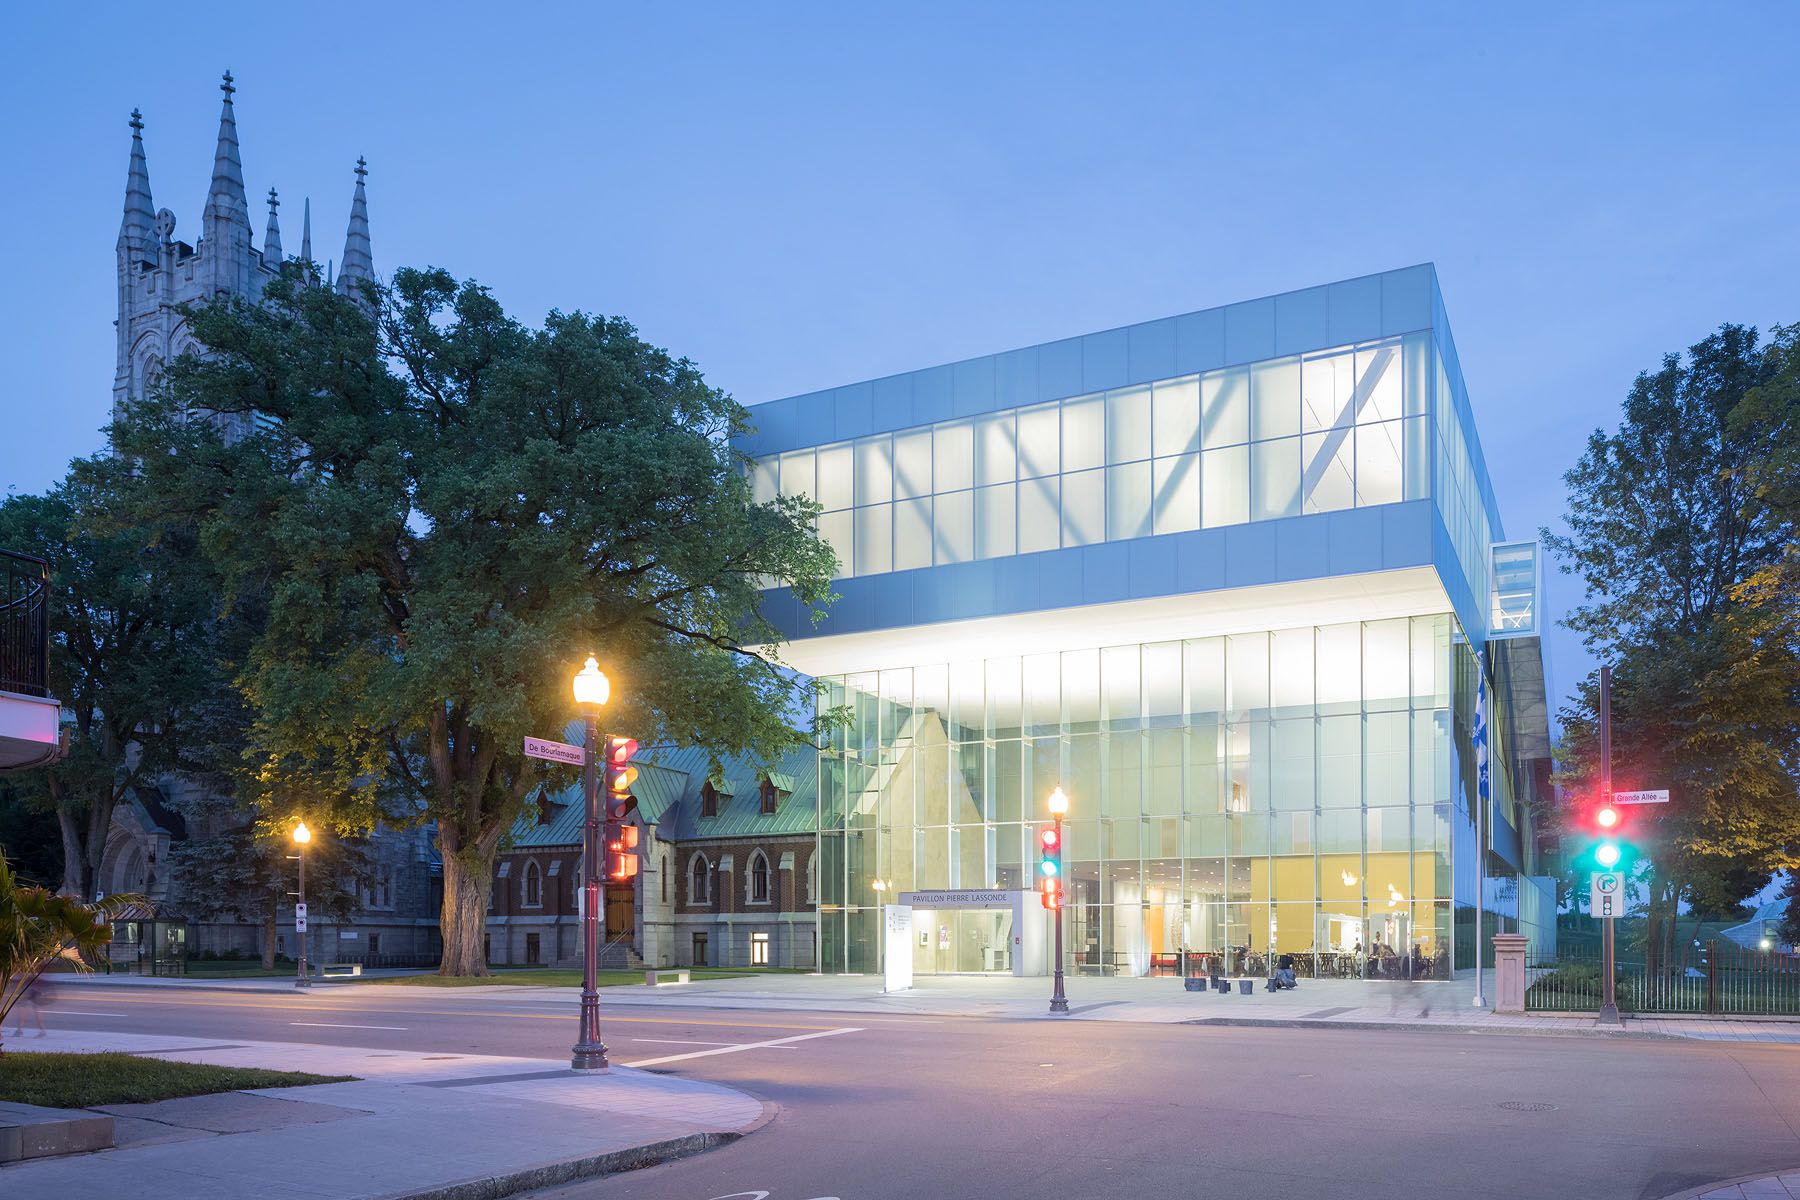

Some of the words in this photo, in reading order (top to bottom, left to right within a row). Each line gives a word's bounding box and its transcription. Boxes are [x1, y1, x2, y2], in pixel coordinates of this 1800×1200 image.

[529, 743, 538, 752] De
[541, 745, 581, 760] Bourlamaque
[1617, 794, 1640, 802] Grande
[1641, 792, 1657, 801] Allée
[912, 895, 944, 903] PAVILLON
[946, 894, 969, 902] PIERRE
[971, 893, 1007, 902] LASSONDE
